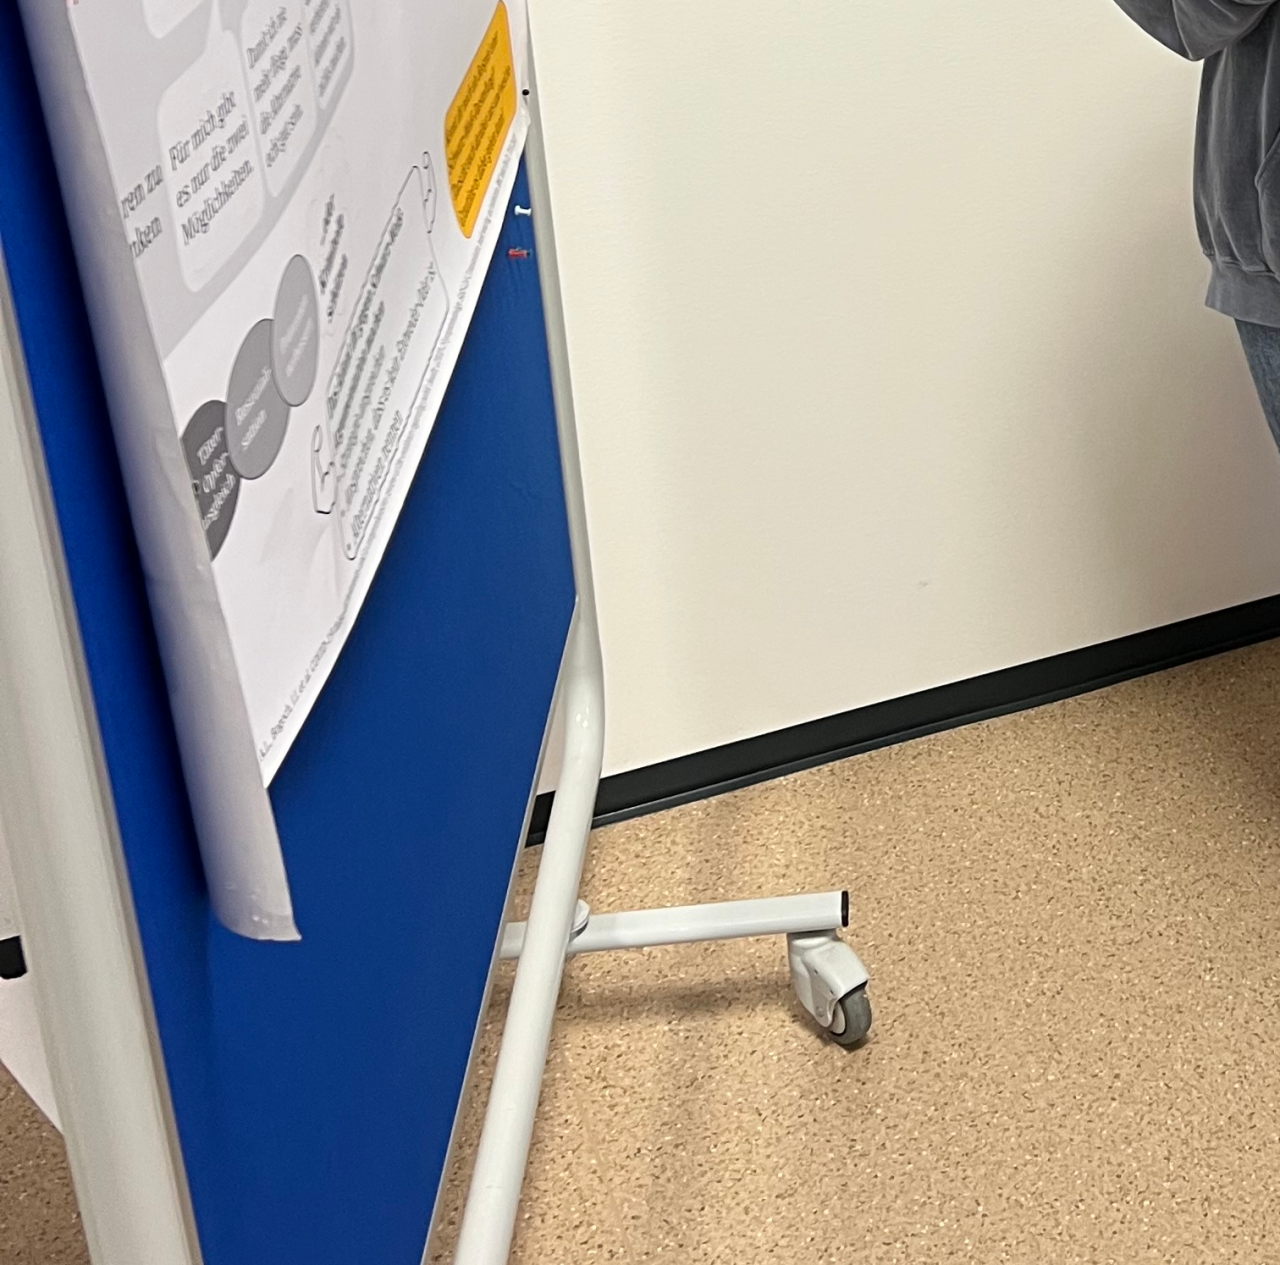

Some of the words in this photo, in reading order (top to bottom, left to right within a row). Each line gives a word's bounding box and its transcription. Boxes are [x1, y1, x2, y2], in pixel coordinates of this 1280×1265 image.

[168, 140, 190, 171] Für
[190, 110, 217, 150] mich
[176, 184, 191, 208] es
[190, 162, 210, 194] nur
[210, 144, 228, 172] die
